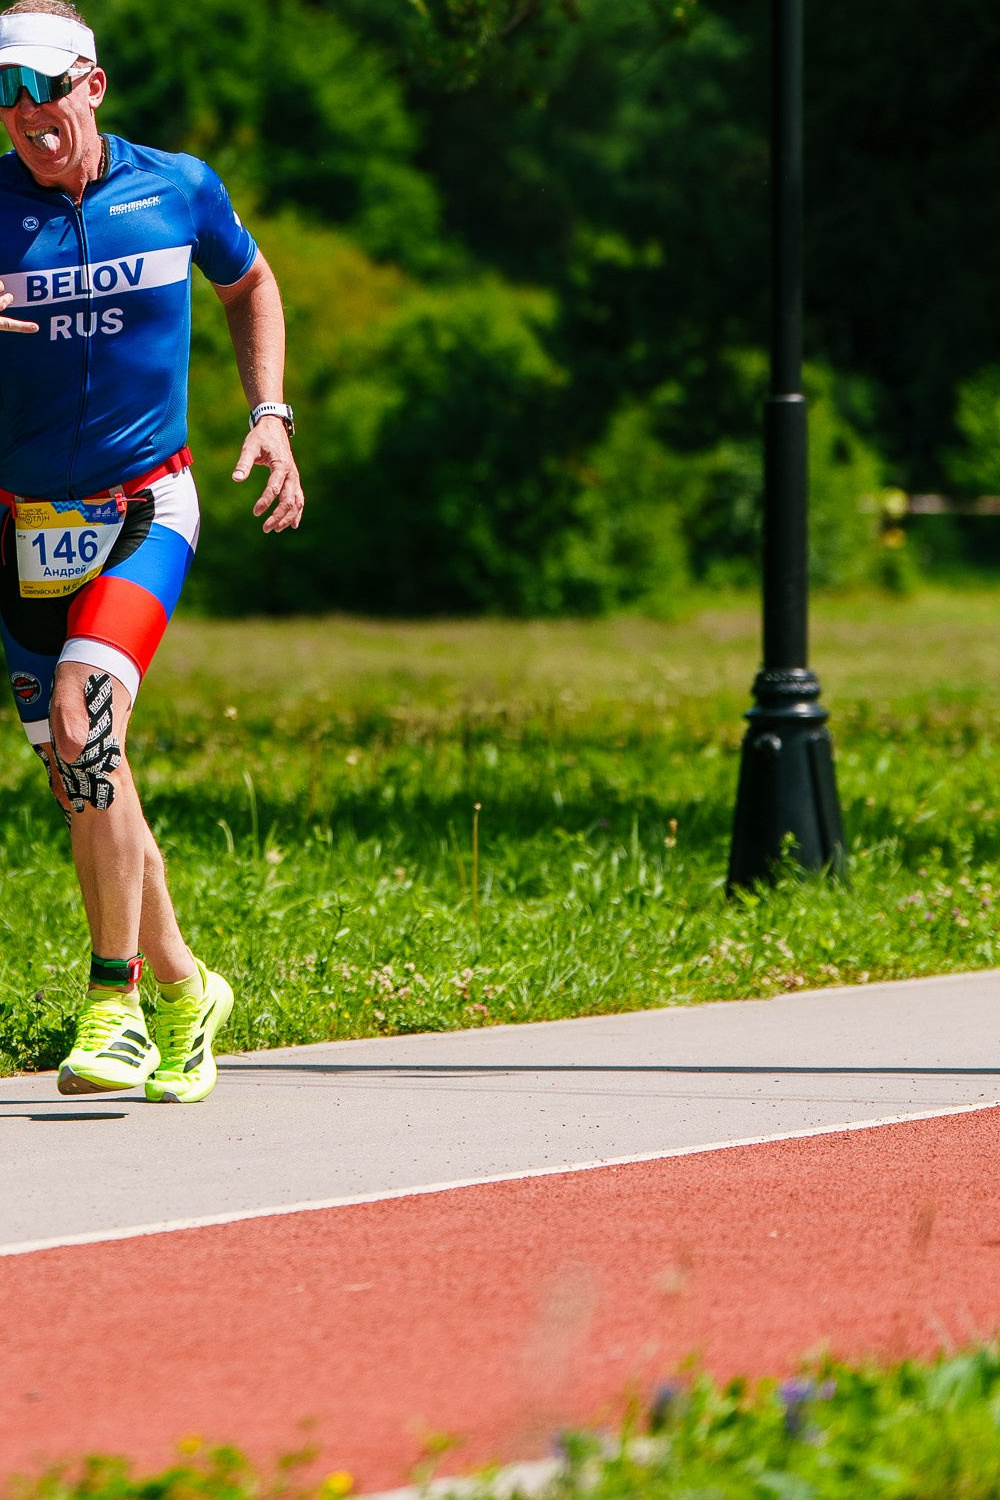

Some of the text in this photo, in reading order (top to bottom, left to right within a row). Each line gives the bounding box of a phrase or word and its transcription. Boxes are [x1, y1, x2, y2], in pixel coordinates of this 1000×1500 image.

[26, 257, 144, 302] BELOV
[49, 307, 124, 341] RUS
[32, 529, 98, 566] 146
[43, 564, 87, 578] Андрей
